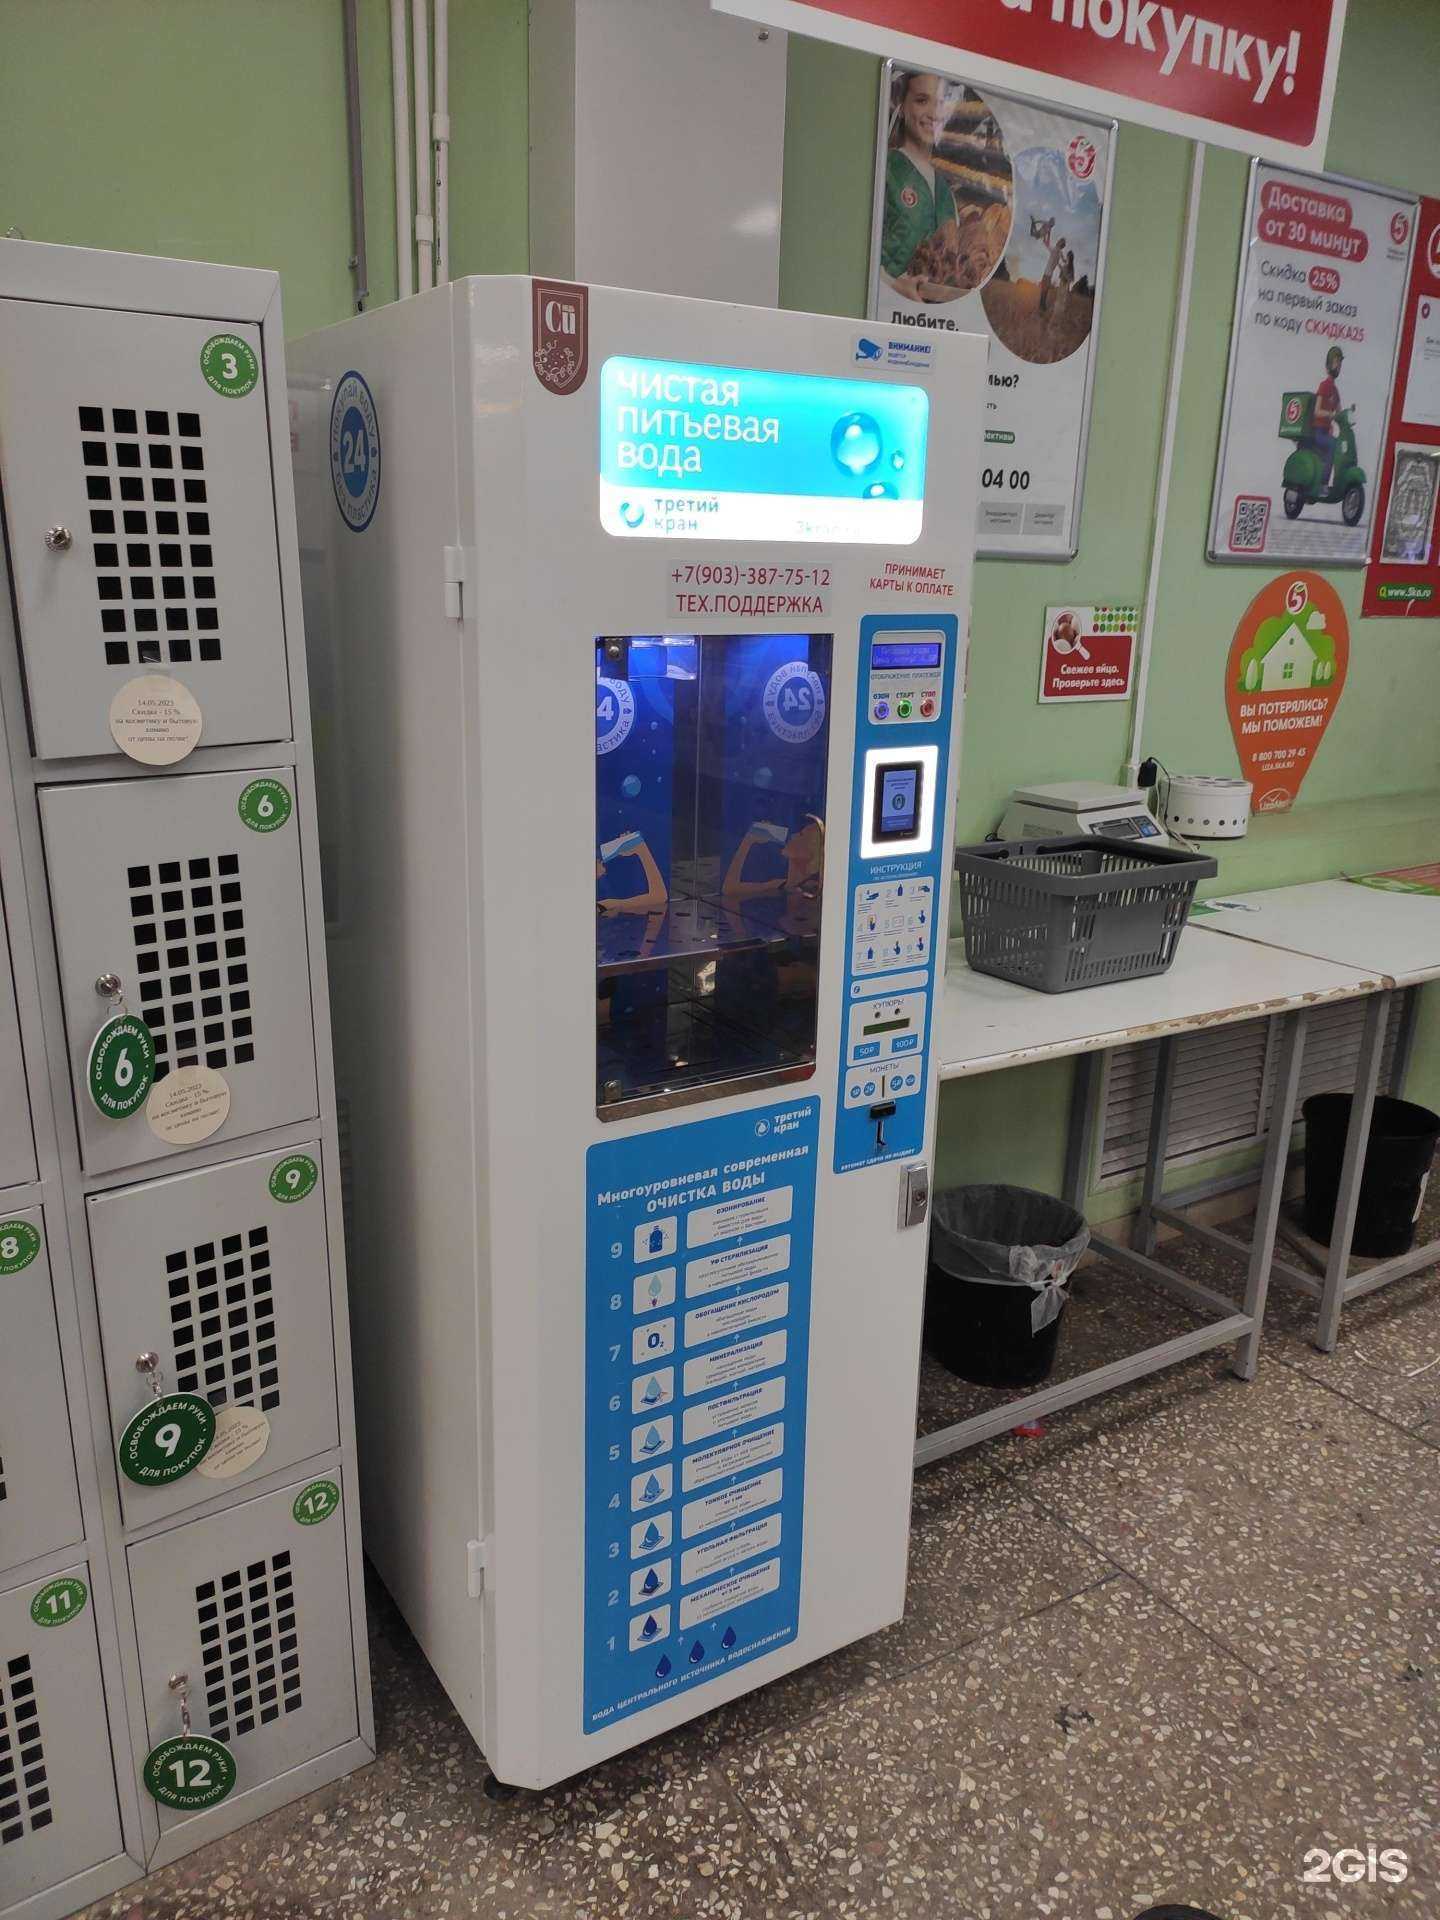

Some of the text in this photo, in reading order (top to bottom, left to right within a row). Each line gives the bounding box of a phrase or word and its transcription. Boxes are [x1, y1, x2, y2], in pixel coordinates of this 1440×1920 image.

[1268, 187, 1346, 222] Доставка
[1265, 222, 1362, 257] от 30 минут
[1261, 260, 1338, 290] Скидка 25%
[1258, 289, 1358, 318] на первый заказ
[1255, 312, 1365, 343] по коду СКИДКА25
[888, 341, 932, 354] ВНИМАНИЕ!
[222, 353, 238, 379] 3
[618, 369, 740, 407] чистая
[617, 406, 779, 443] питьевая
[343, 429, 367, 474] 24
[617, 441, 702, 478] вода
[981, 468, 1030, 490] 04 00
[655, 496, 719, 513] третий
[654, 517, 698, 532] кран
[672, 563, 830, 586] +7(903)-387-75-12
[885, 563, 946, 580] ПРИНИМАЕТ
[869, 578, 954, 596] КАРТЫ К ОПЛАТЕ
[1387, 587, 1431, 599] www.5ka.ru
[676, 594, 823, 616] ТЕХ.ПОДДЕРЖКА
[1061, 664, 1119, 675] Свежее яйцо.
[1053, 677, 1125, 690] Проверьте здесь
[1240, 698, 1328, 717] ВЫ ПОТЕРЯЛИСЬ?
[1242, 715, 1323, 734] МЫ ПОМОЖЕМ!
[258, 794, 274, 817] 6
[870, 861, 922, 875] ИНСТРУКЦИЯ
[873, 998, 904, 1009] КУПЮРЫ
[95, 1025, 150, 1080] ОСВОБОЖДАЕМ РУКИ
[115, 1047, 133, 1087] 6
[870, 1063, 900, 1073] МОНЕТЫ
[100, 1074, 149, 1110] ДЛЯ ПОКУПОК
[774, 1106, 812, 1125] третий
[773, 1121, 800, 1135] кран
[285, 1169, 300, 1190] 9
[597, 1144, 810, 1206] Многоуровневая современная
[646, 1172, 765, 1214] ОЧИСТКА ВОДЫ
[716, 1197, 765, 1214] ОЗОНИРОВАНИЕ
[1, 1236, 19, 1259] 8
[610, 1242, 623, 1259] 9
[720, 1244, 768, 1263] СТЕРИЛИЗАЦИЯ
[610, 1294, 622, 1311] 8
[695, 1288, 779, 1319] ОБОГАЩЕНИЕ КИСЛОРОДОМ
[609, 1344, 621, 1362] 7
[710, 1341, 763, 1362] МИНЕРАЛИЗАЦИЯ
[609, 1395, 621, 1411] 6
[129, 1402, 188, 1460] ОСВОБОЖДАЕМ
[187, 1405, 208, 1424] РУКИ
[155, 1423, 182, 1458] 9
[608, 1444, 621, 1461] 5
[692, 1443, 740, 1464] МОЛЕКУЛЯРНОЕ
[742, 1429, 774, 1446] ОЧИЩЕНИЕ
[139, 1466, 161, 1478] ДЛЯ
[163, 1438, 206, 1477] ПОКУПОК
[304, 1492, 328, 1514] 12
[608, 1493, 621, 1509] 4
[608, 1542, 620, 1558] 3
[697, 1539, 728, 1555] УГОЛЬНАЯ
[690, 1579, 738, 1603] МЕХАНИЧЕСКОЕ
[738, 1565, 770, 1583] ОЧИЩЕНИЕ
[46, 1590, 71, 1614] 11
[608, 1590, 620, 1607] 2
[606, 1636, 617, 1652] 1
[592, 1626, 791, 1721] ВОДА ЦЕНТРАЛЬНОГО ИСТОЧНИКА ВОДОСНАБЖЕНИЯ
[153, 1743, 228, 1777] ОСВОБОЖДАЕМ РУКИ
[169, 1759, 211, 1788] 12
[158, 1784, 224, 1803] ДЛЯ ПОКУПОК
